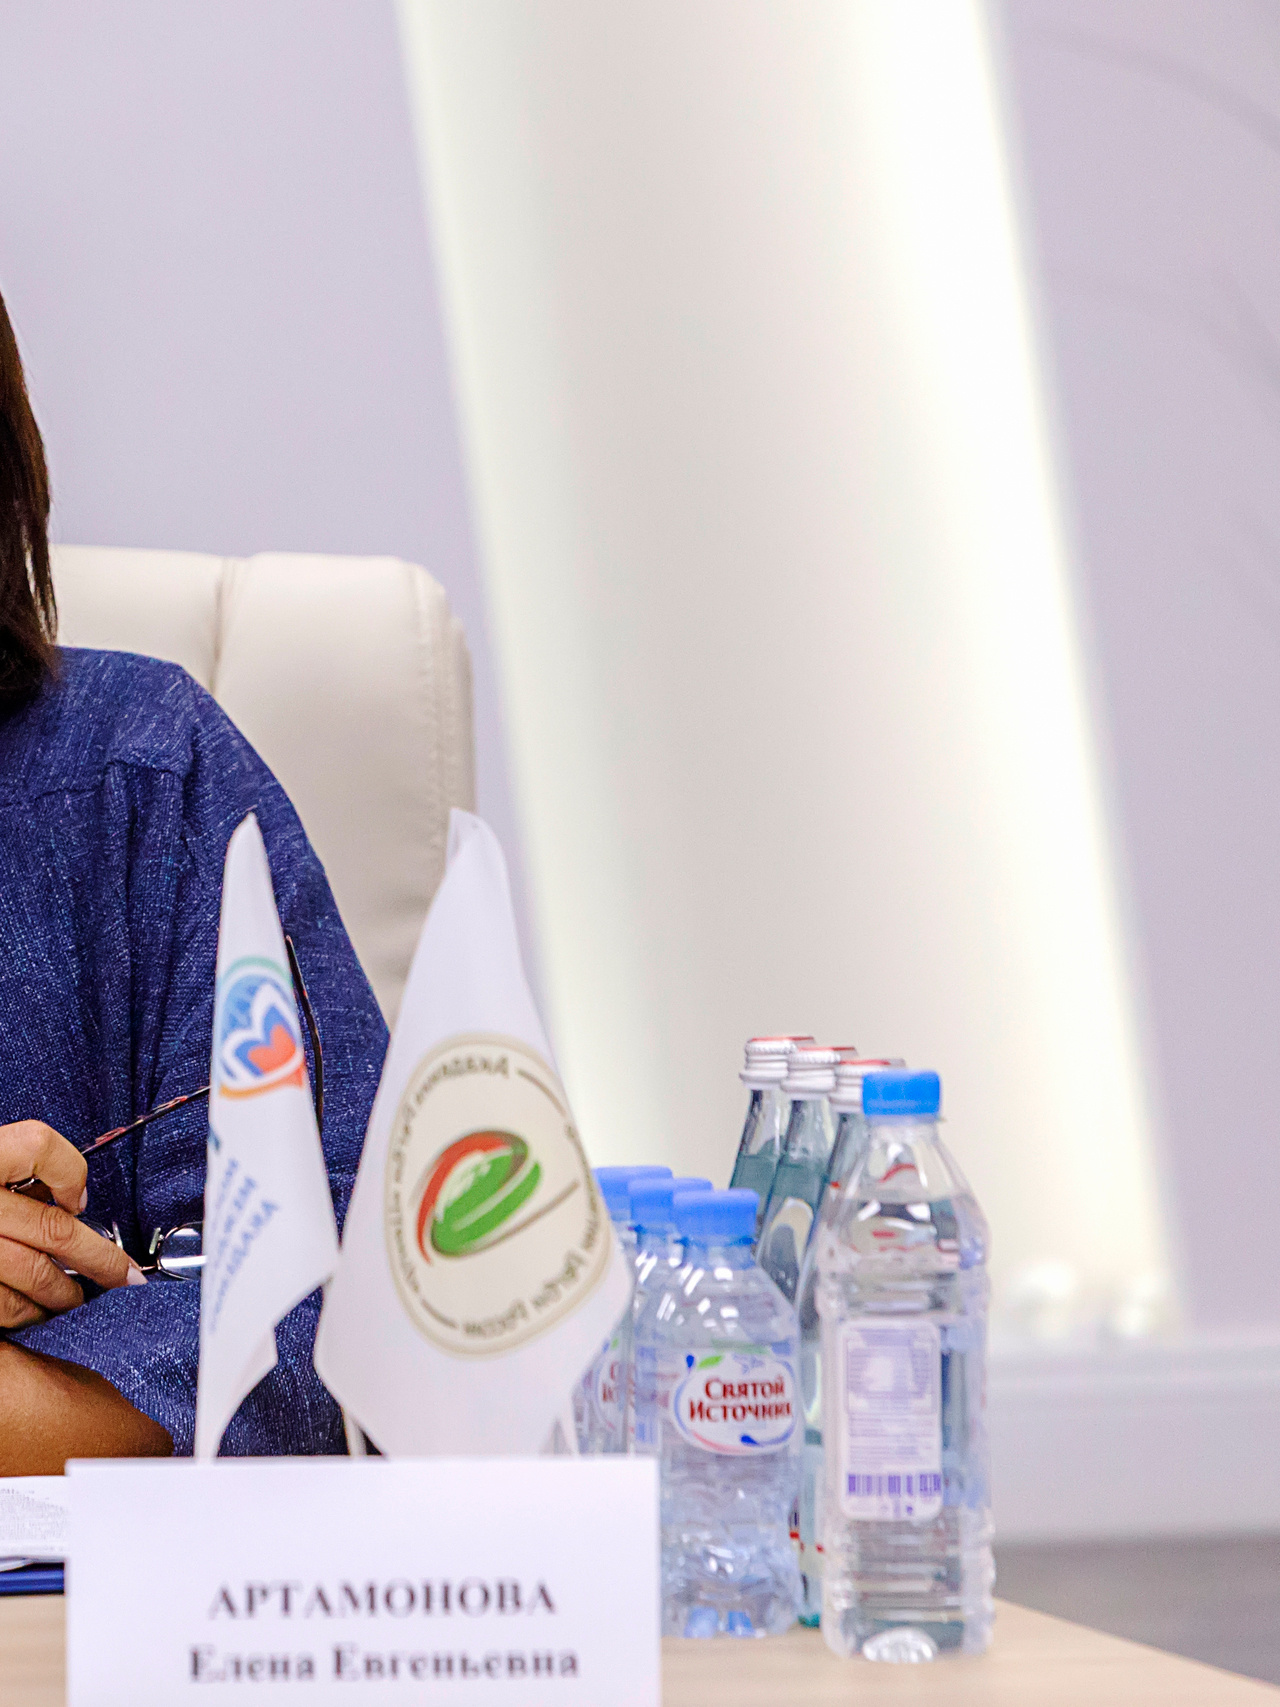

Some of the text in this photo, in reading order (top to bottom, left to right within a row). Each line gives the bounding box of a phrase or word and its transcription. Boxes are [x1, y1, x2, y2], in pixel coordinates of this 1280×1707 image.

[704, 1374, 786, 1400] Святой
[208, 1578, 558, 1620] АРТАМОНОВА
[188, 1641, 580, 1684] Елена Евгеньевна
